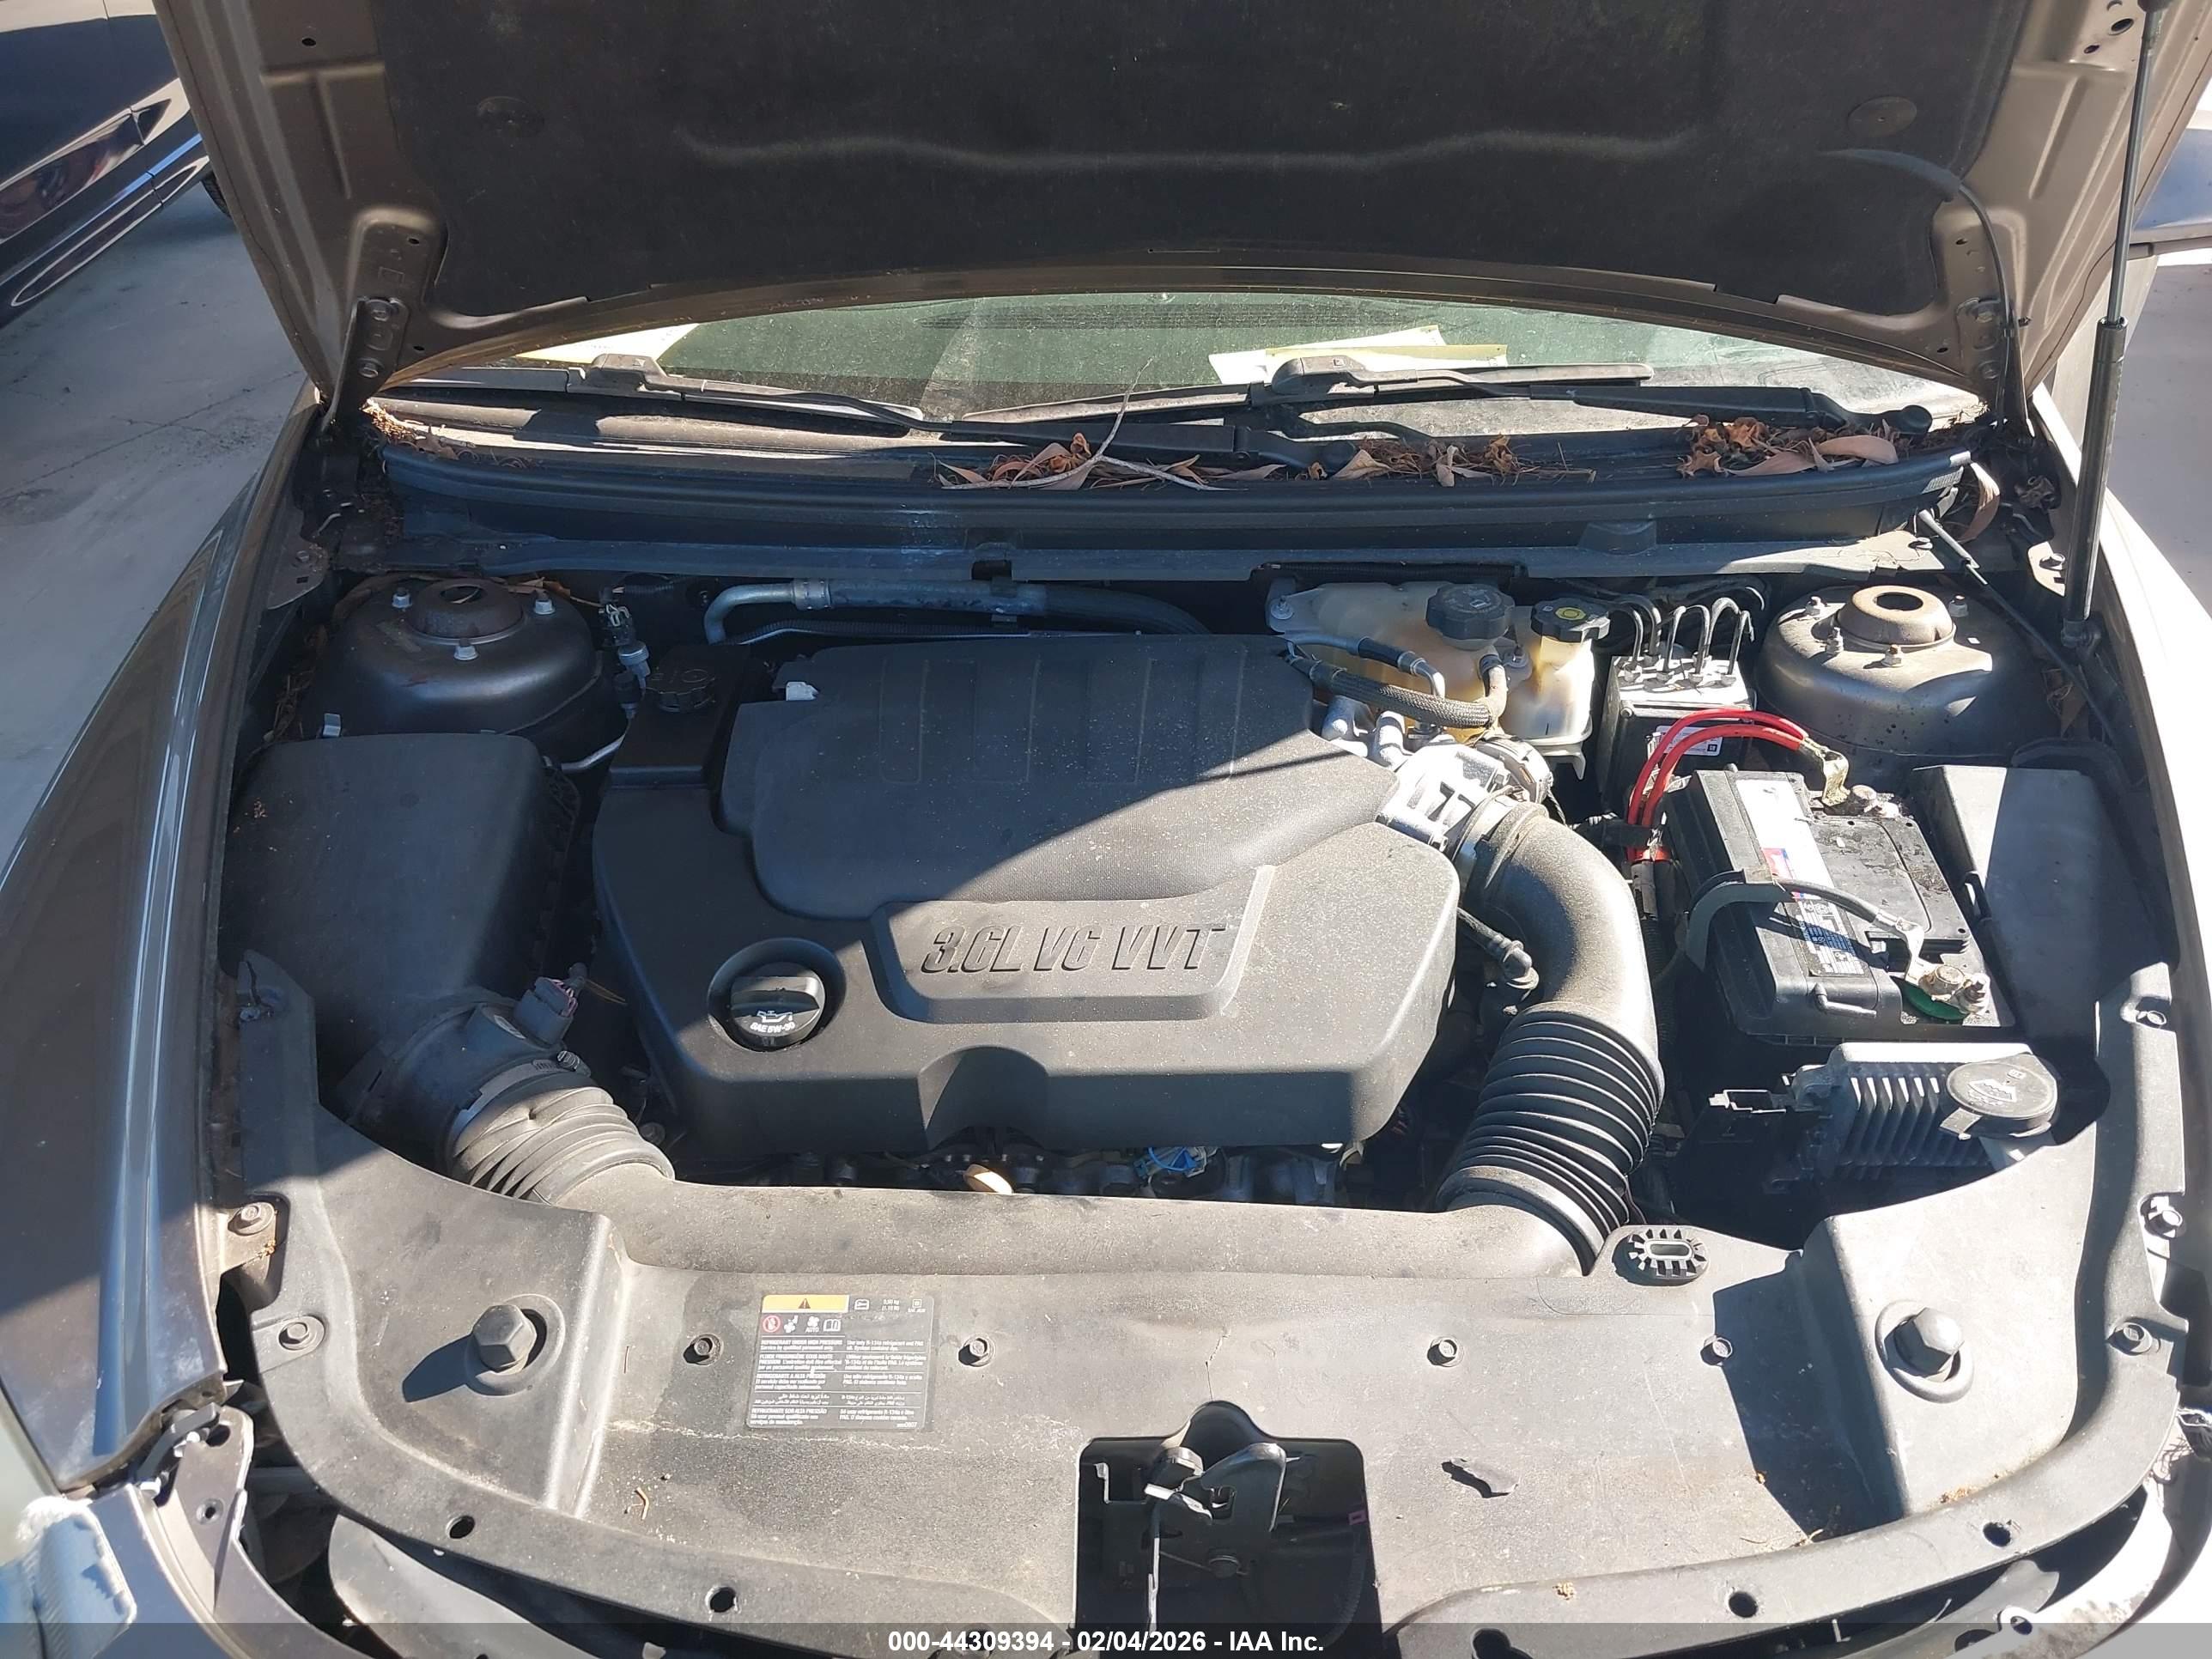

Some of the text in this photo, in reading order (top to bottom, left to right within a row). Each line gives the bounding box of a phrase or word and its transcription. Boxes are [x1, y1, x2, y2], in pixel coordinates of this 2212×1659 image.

[921, 924, 1228, 974] 3.6L V6 VVT
[750, 1022, 768, 1032] SAE
